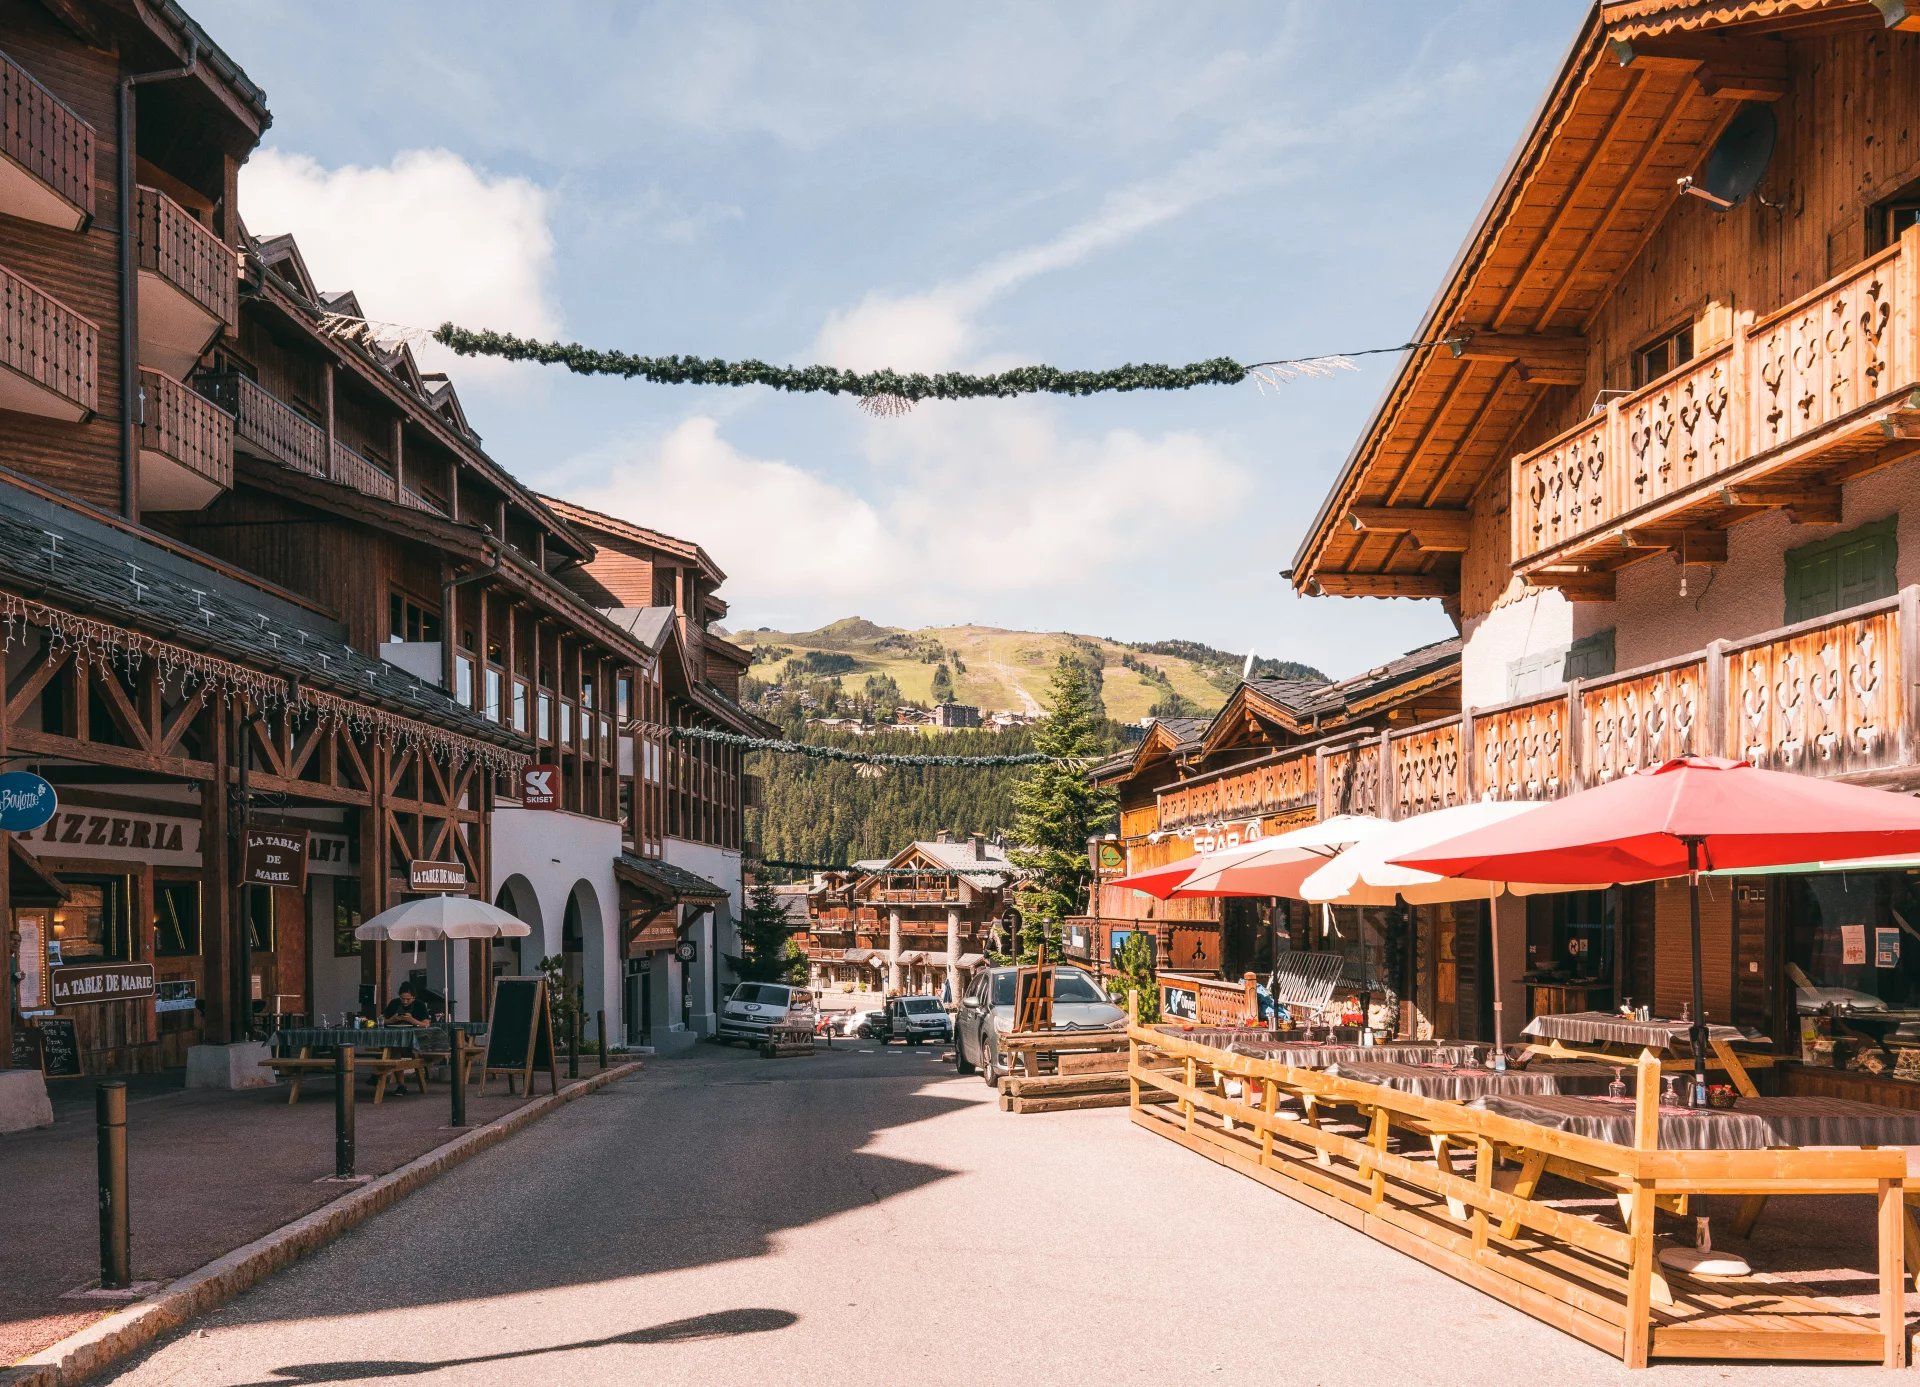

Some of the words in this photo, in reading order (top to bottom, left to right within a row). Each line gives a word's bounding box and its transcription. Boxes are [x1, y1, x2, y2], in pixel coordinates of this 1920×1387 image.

[526, 796, 554, 804] SKISET
[248, 837, 264, 848] LA
[265, 836, 301, 853] TABLE
[1194, 831, 1240, 855] SPAR
[266, 855, 282, 865] DE
[254, 868, 290, 881] MARIE
[413, 871, 421, 883] LA
[421, 868, 440, 883] TABLE
[440, 868, 447, 884] DE
[55, 982, 70, 997] LA
[70, 975, 104, 995] TABLE
[105, 974, 120, 992] DE
[121, 975, 153, 991] MARIE
